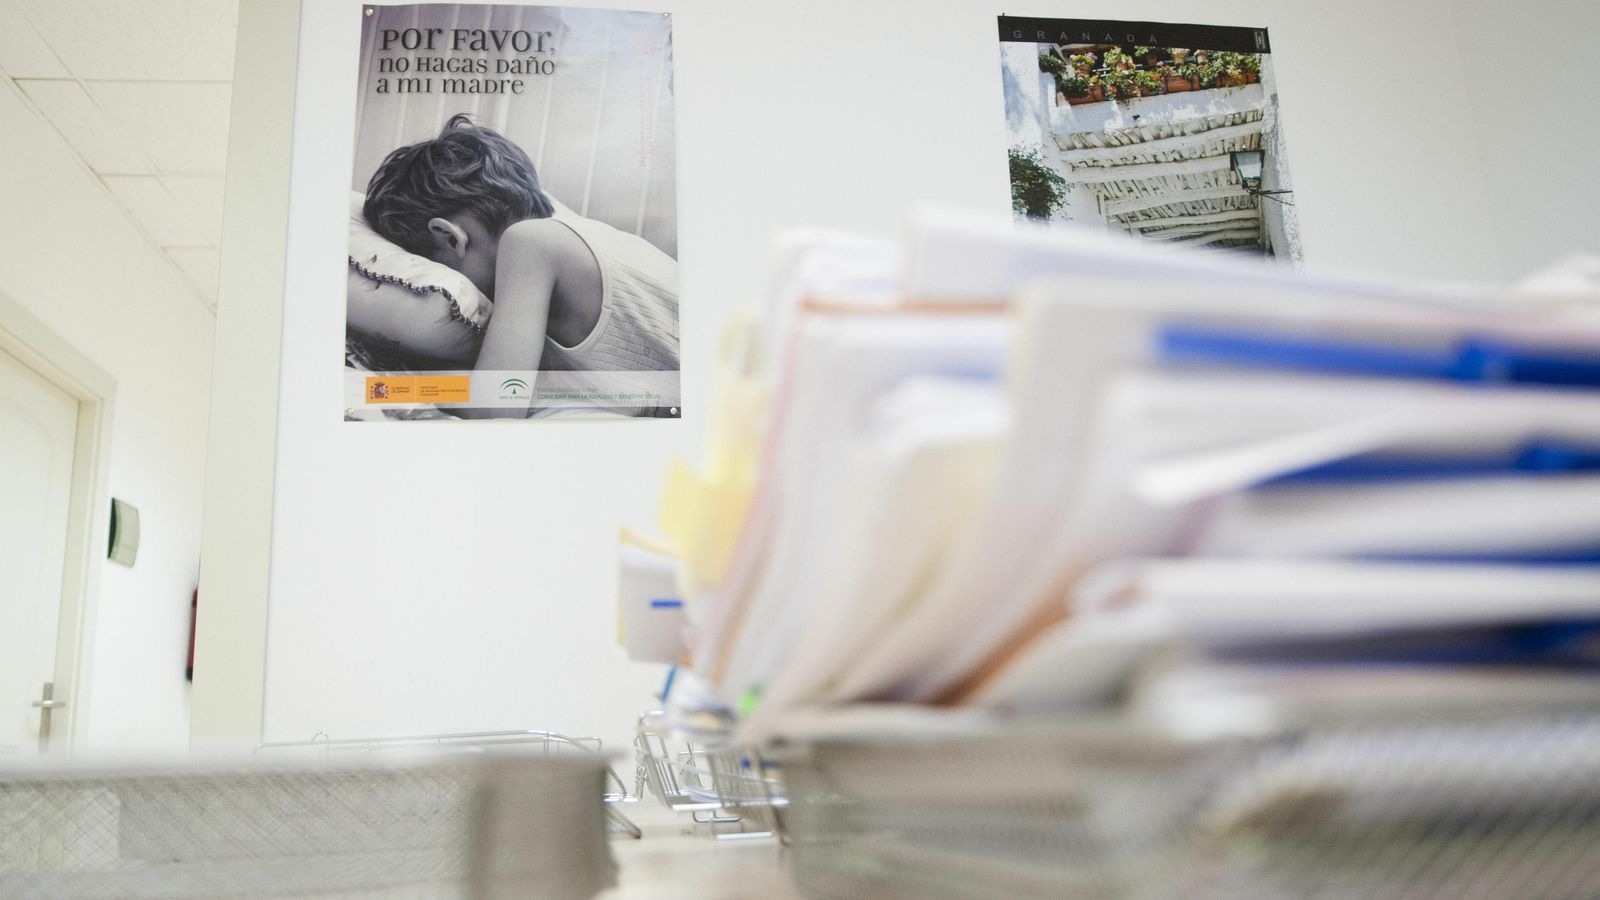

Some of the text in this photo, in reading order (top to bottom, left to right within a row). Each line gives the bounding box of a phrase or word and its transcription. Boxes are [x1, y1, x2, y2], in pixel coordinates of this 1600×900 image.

[1013, 29, 1158, 44] GRANADA
[378, 56, 410, 73] no
[376, 77, 390, 94] a
